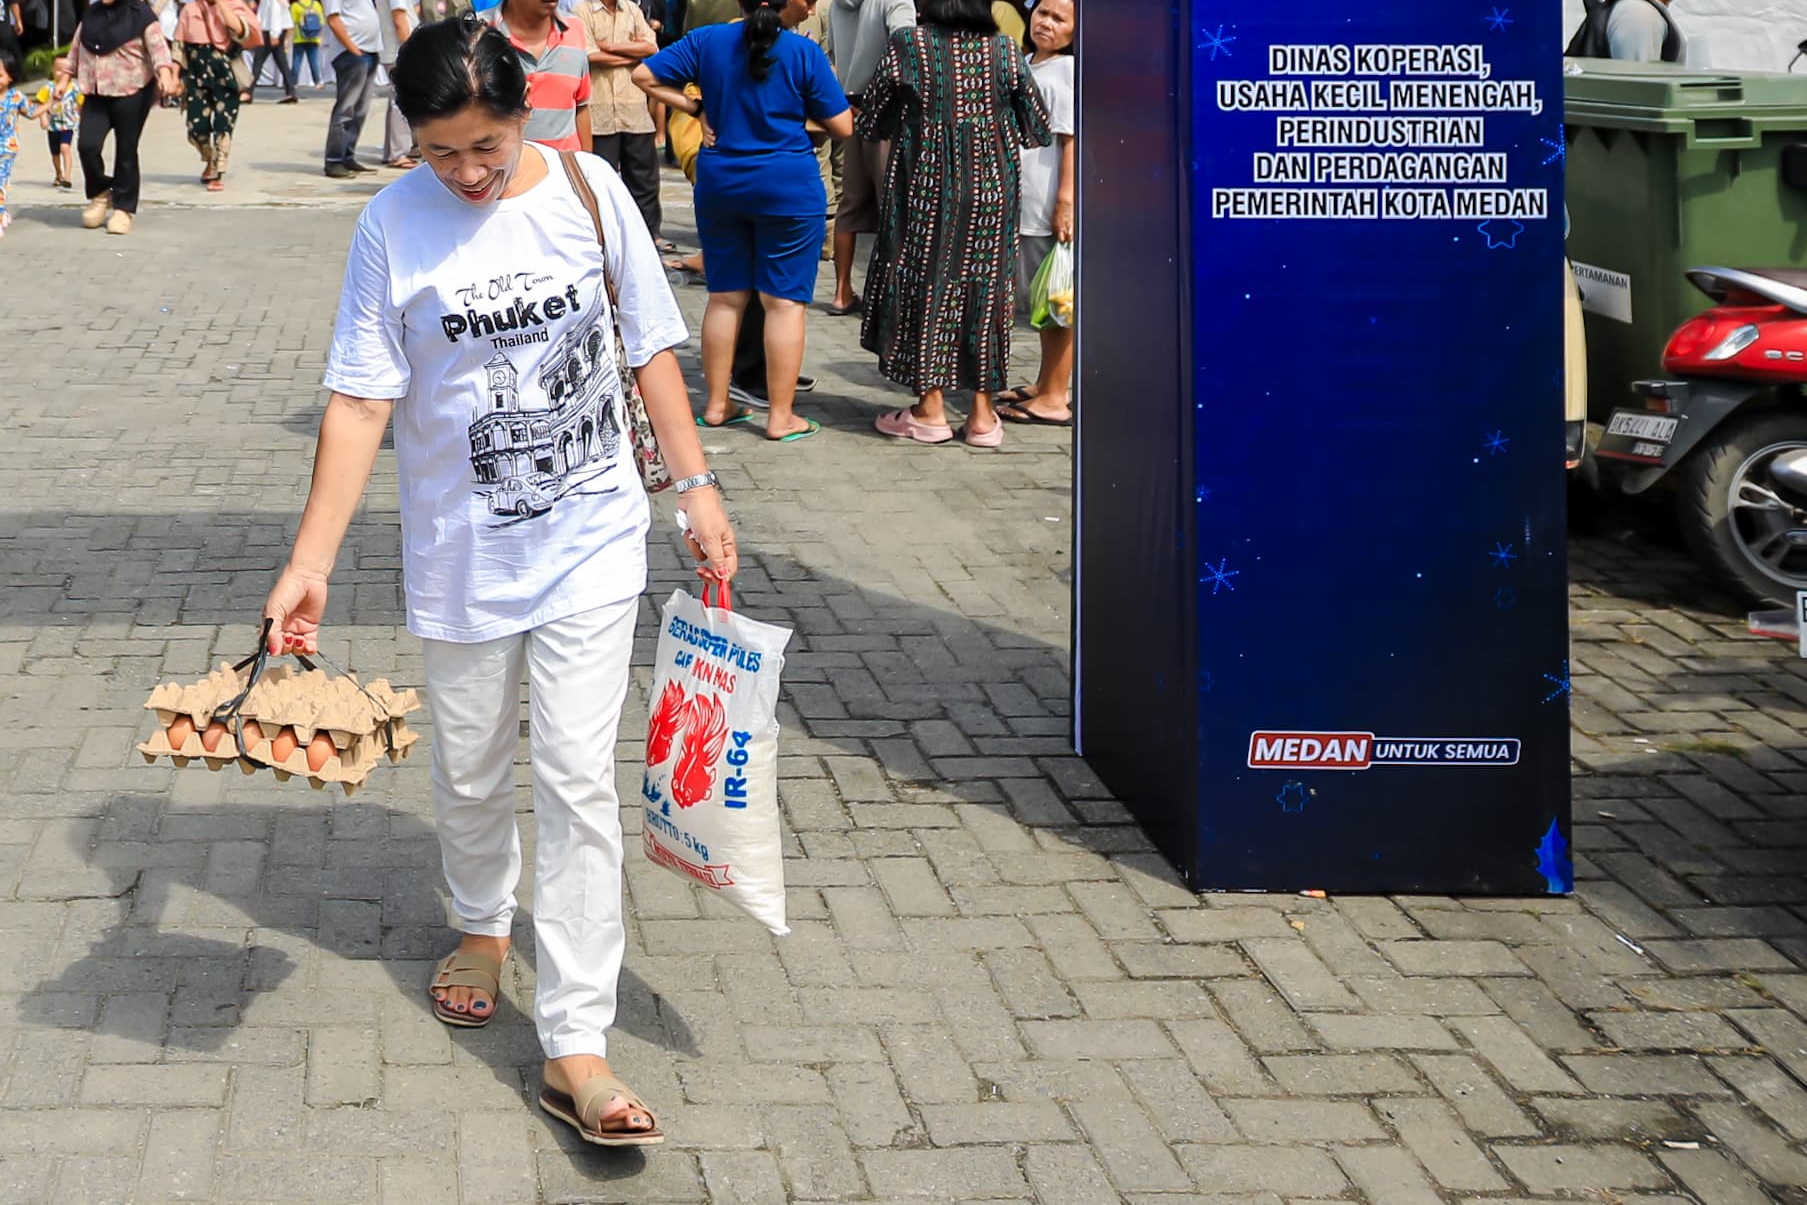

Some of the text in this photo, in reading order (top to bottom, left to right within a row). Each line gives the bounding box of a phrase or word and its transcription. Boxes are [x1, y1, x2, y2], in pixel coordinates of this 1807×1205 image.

[1269, 45, 1490, 79] DINAS KOPERASI,
[1217, 81, 1542, 115] USAHA KECIL MENENGAH,
[1277, 117, 1483, 147] PERINDUSTRIAN
[1254, 153, 1507, 182] DAN PERDAGANGAN
[1212, 189, 1547, 219] PEMERINTAH KOTA MEDAN
[455, 272, 554, 306] The Old Town
[440, 284, 581, 343] Phuket
[490, 327, 549, 349] Thailand
[1254, 738, 1510, 762] MEDAN UNTUK SEMUA
[724, 731, 753, 809] IR-64
